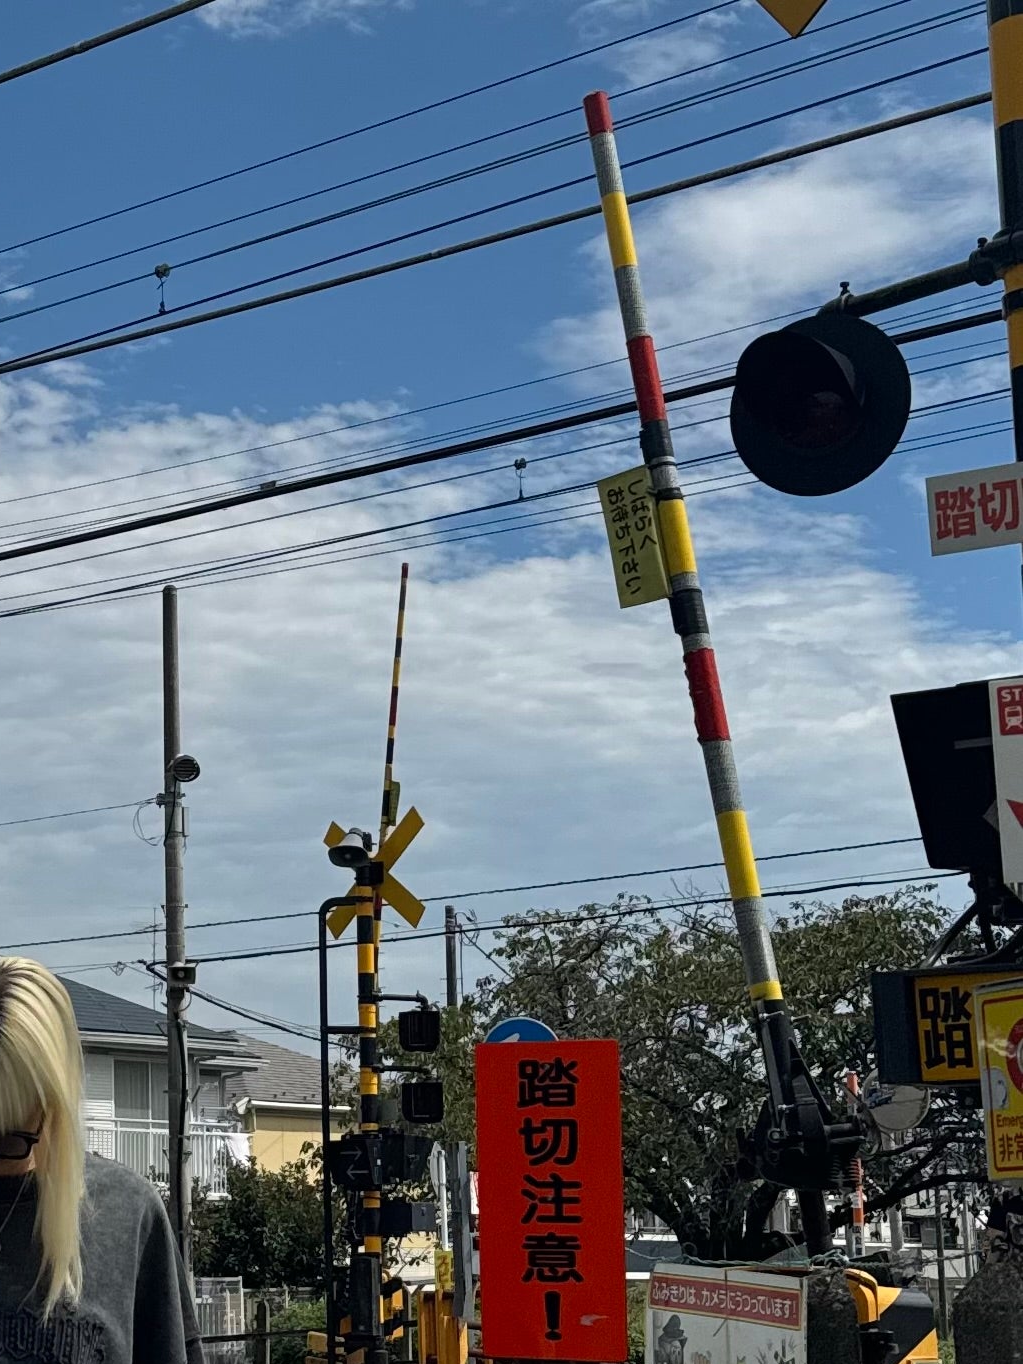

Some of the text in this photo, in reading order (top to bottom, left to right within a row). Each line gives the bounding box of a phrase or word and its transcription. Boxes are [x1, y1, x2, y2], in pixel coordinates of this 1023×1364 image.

[607, 486, 641, 595] お待ち下さい
[628, 479, 657, 550] しばらく
[934, 480, 1020, 540] 踏切
[1000, 688, 1023, 702] ST
[919, 986, 973, 1069] 踏
[517, 1057, 583, 1341] 踏切注意!
